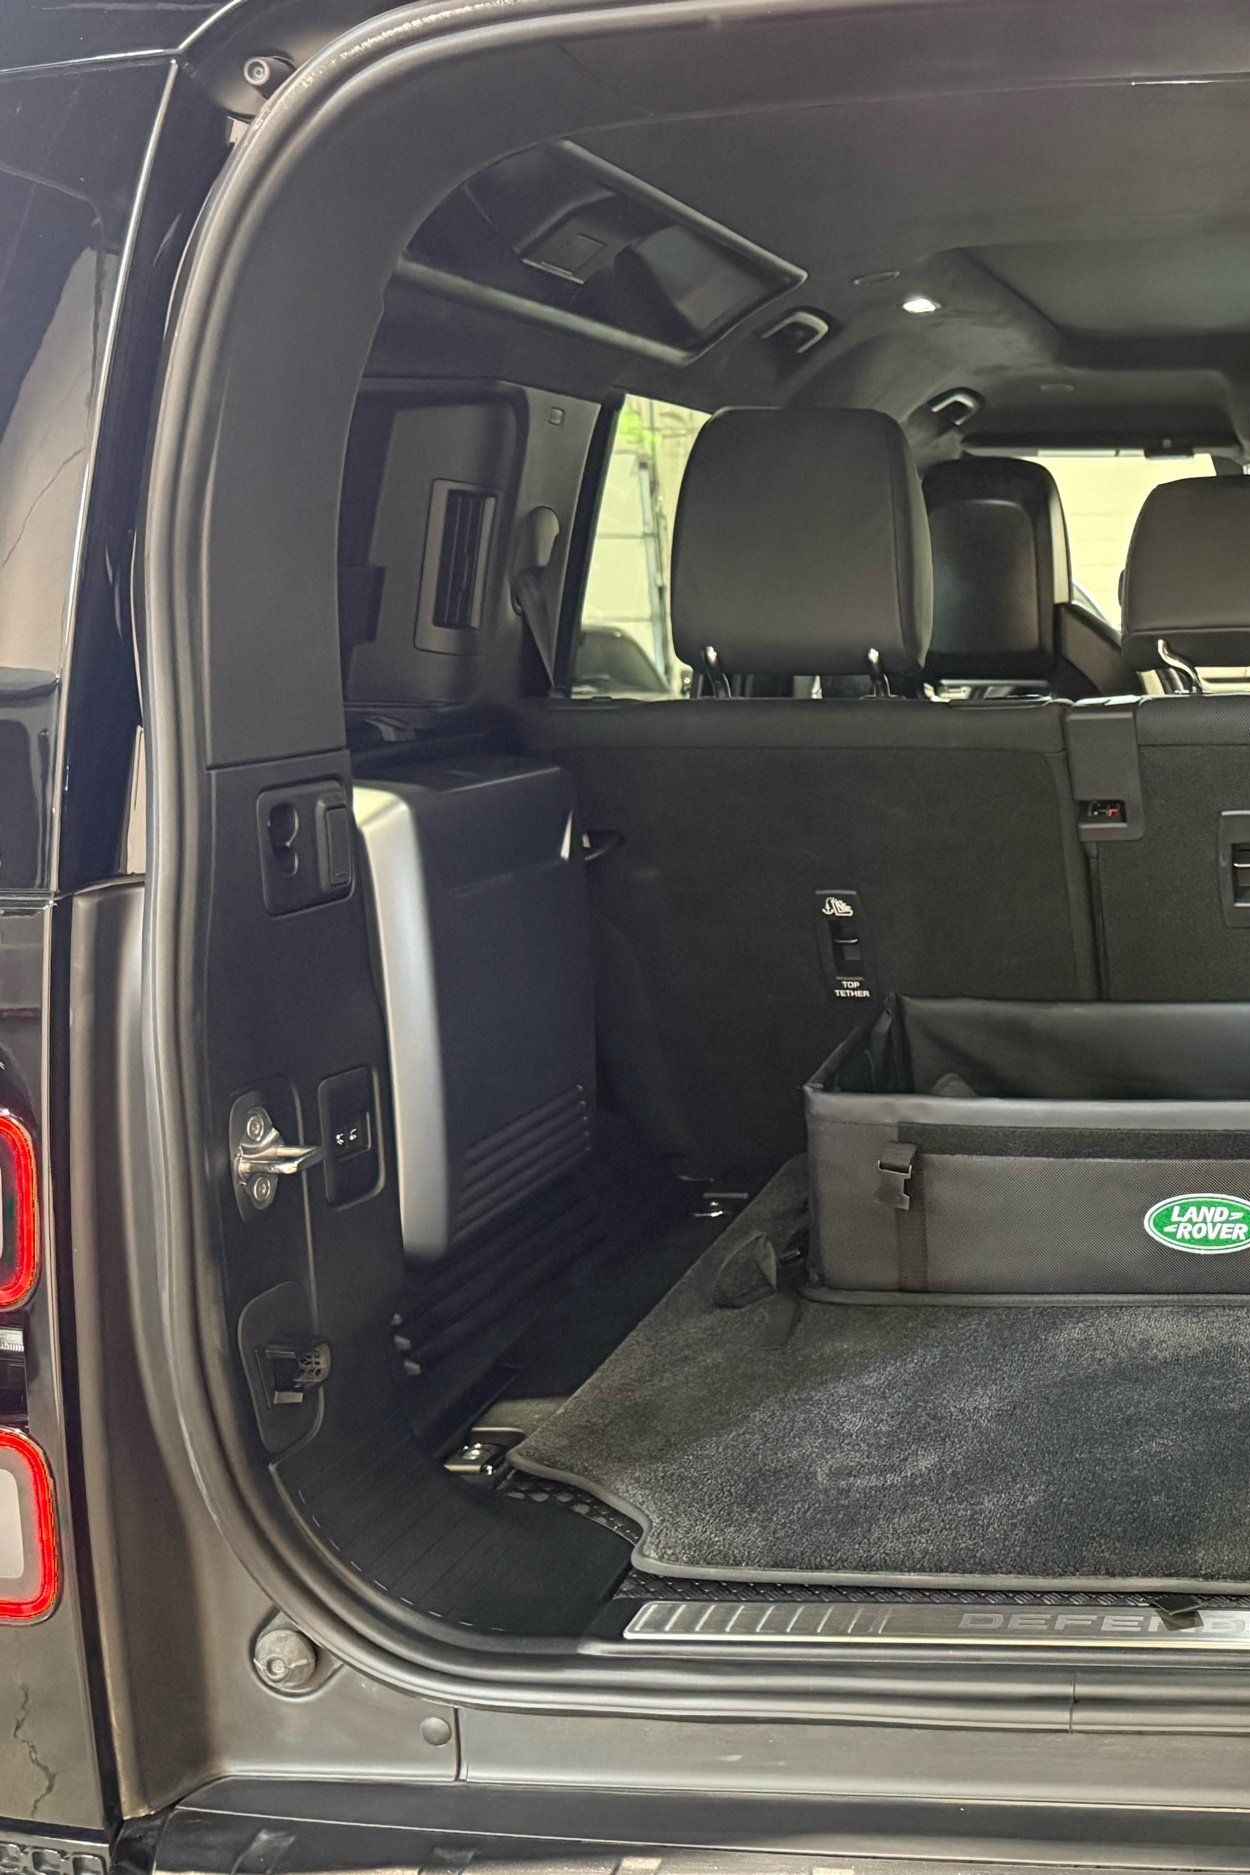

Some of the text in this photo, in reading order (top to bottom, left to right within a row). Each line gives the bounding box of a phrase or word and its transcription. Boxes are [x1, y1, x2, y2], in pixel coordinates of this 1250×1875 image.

[841, 981, 860, 989] TOP
[834, 989, 870, 998] TETHER
[1171, 1205, 1229, 1222] LAND
[1175, 1222, 1248, 1241] ROVER
